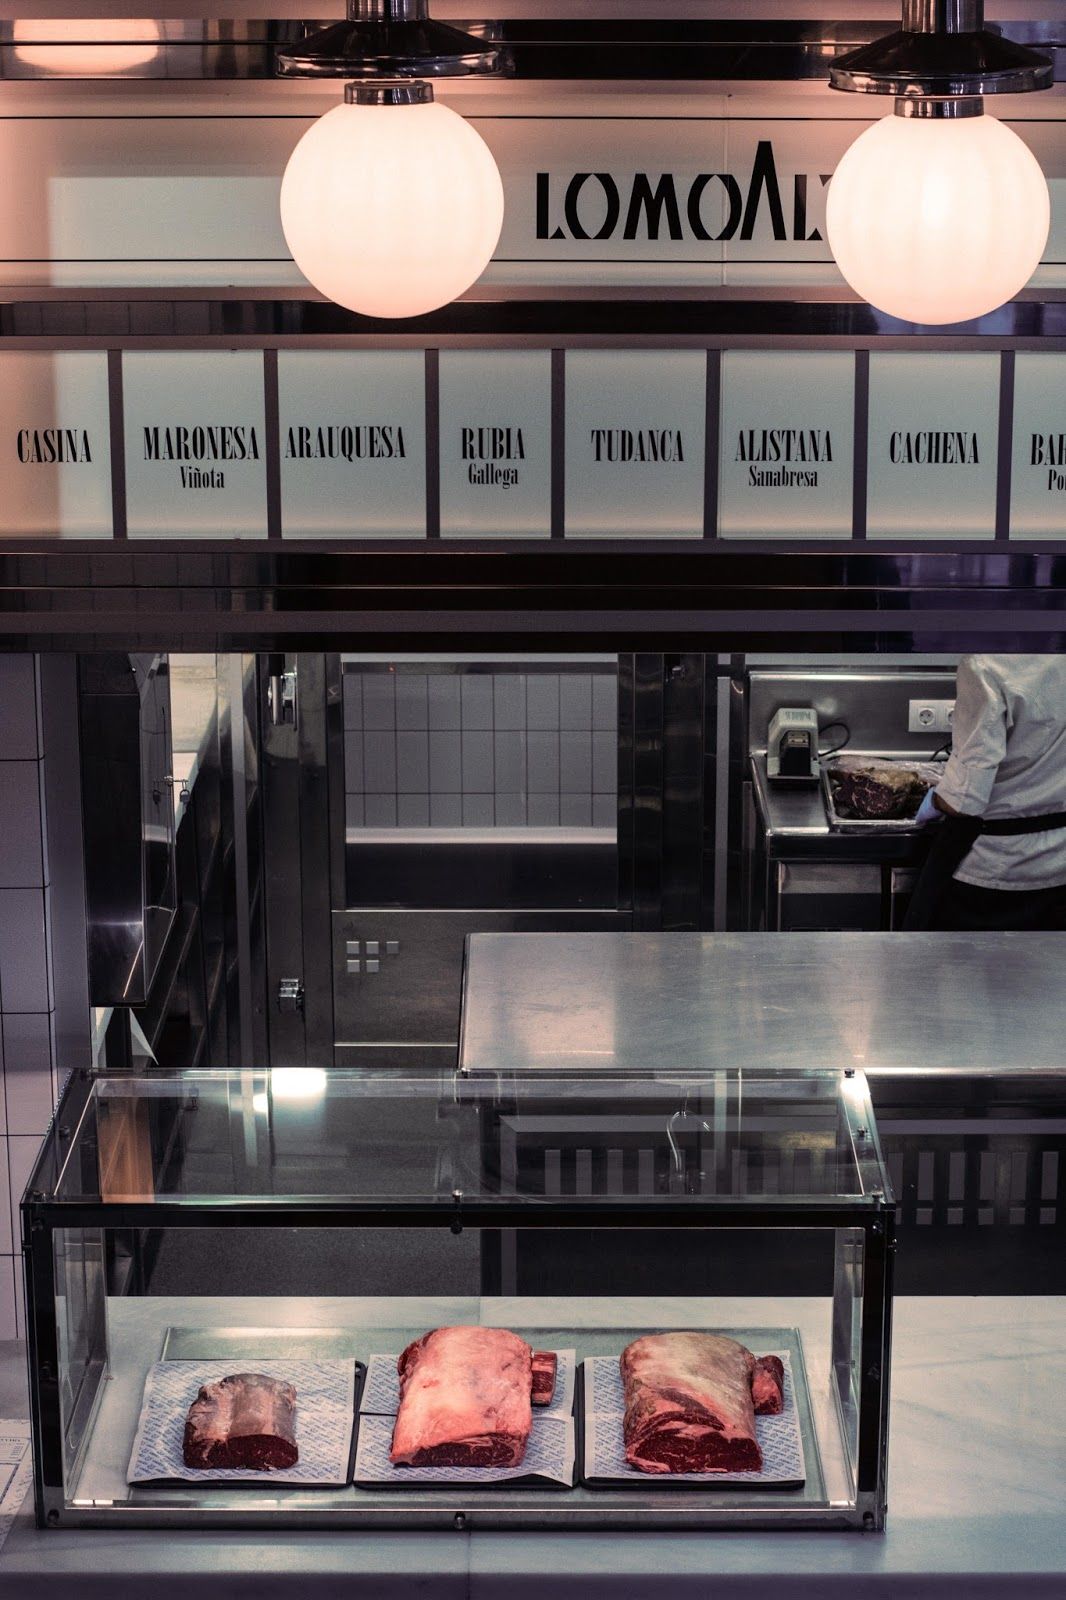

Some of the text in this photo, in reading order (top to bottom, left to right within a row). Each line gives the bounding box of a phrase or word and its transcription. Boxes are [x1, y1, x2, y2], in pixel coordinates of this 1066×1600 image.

[537, 140, 833, 241] LOMOAL
[16, 428, 92, 464] CASINA
[143, 426, 260, 460] MARONESA
[284, 426, 407, 461] ARAUQUESA
[460, 427, 526, 461] RUBIA
[591, 429, 685, 462] TUDANCA
[734, 429, 833, 462] ALISTANA
[889, 432, 980, 465] CACHENA
[180, 465, 225, 489] Viñota
[468, 463, 520, 490] Gallega
[748, 464, 819, 488] Sanabresa
[1047, 468, 1066, 490] Po
